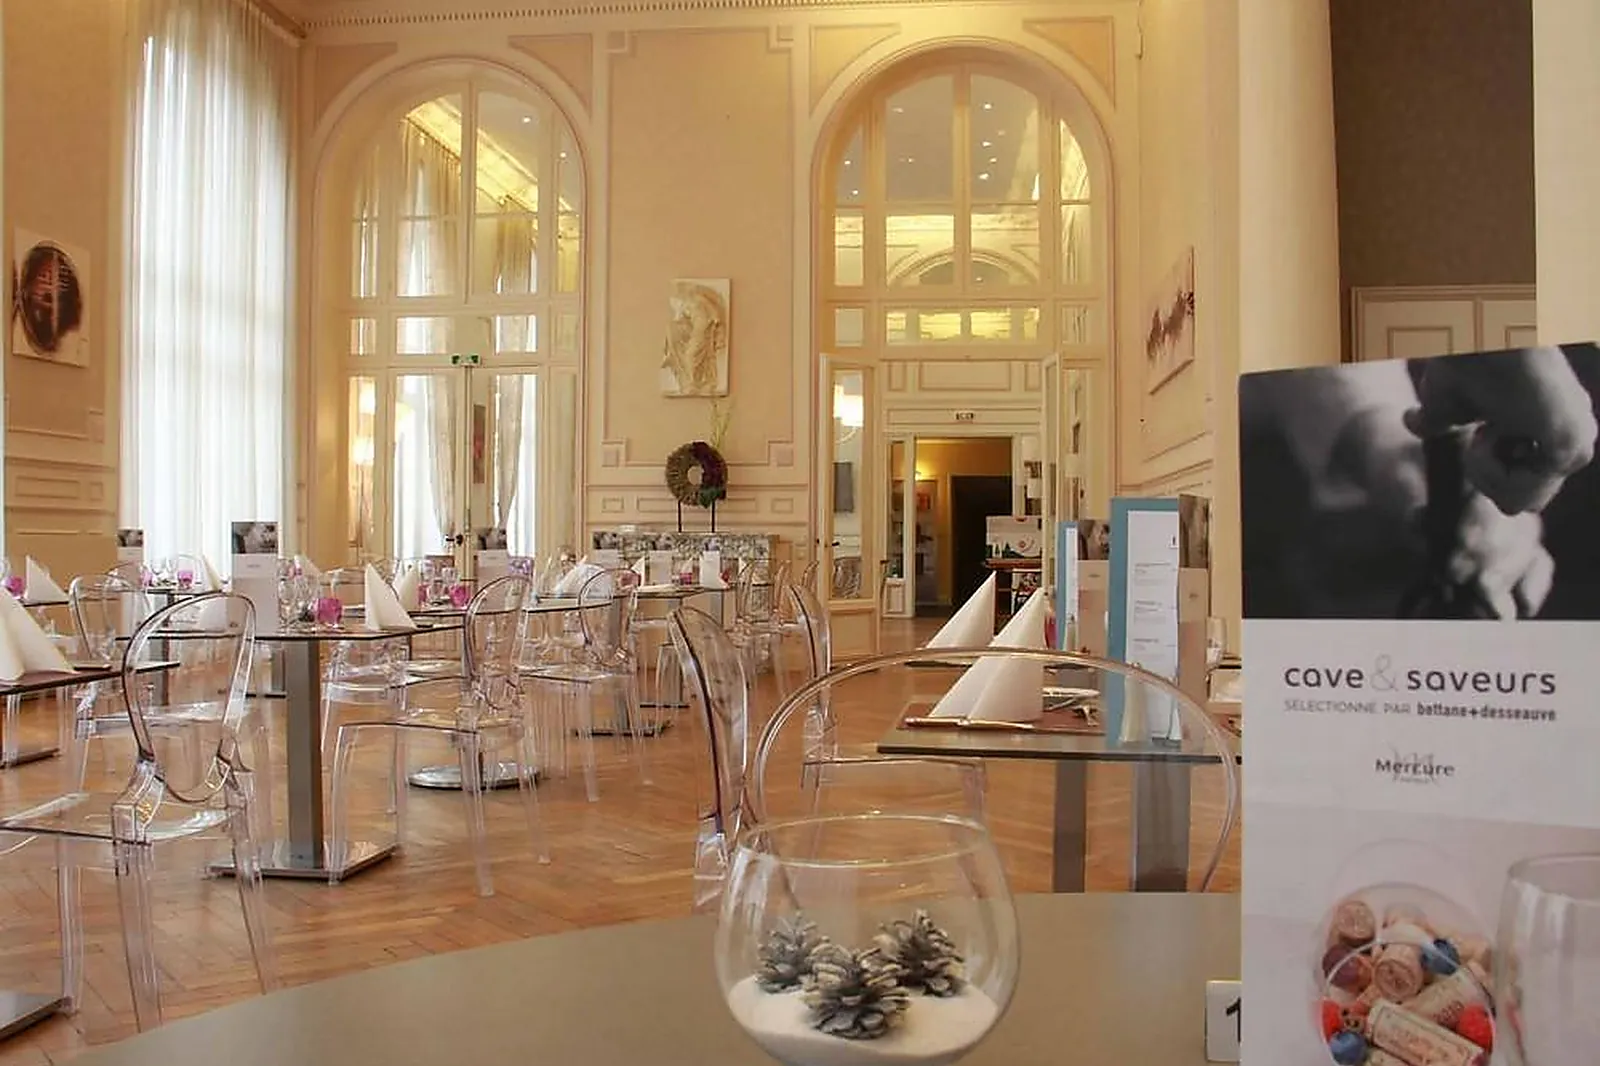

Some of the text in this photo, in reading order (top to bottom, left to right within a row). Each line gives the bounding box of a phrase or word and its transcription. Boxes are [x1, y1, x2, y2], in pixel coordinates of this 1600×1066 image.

[1284, 654, 1557, 695] cave & saveurs
[1383, 702, 1411, 714] PAR
